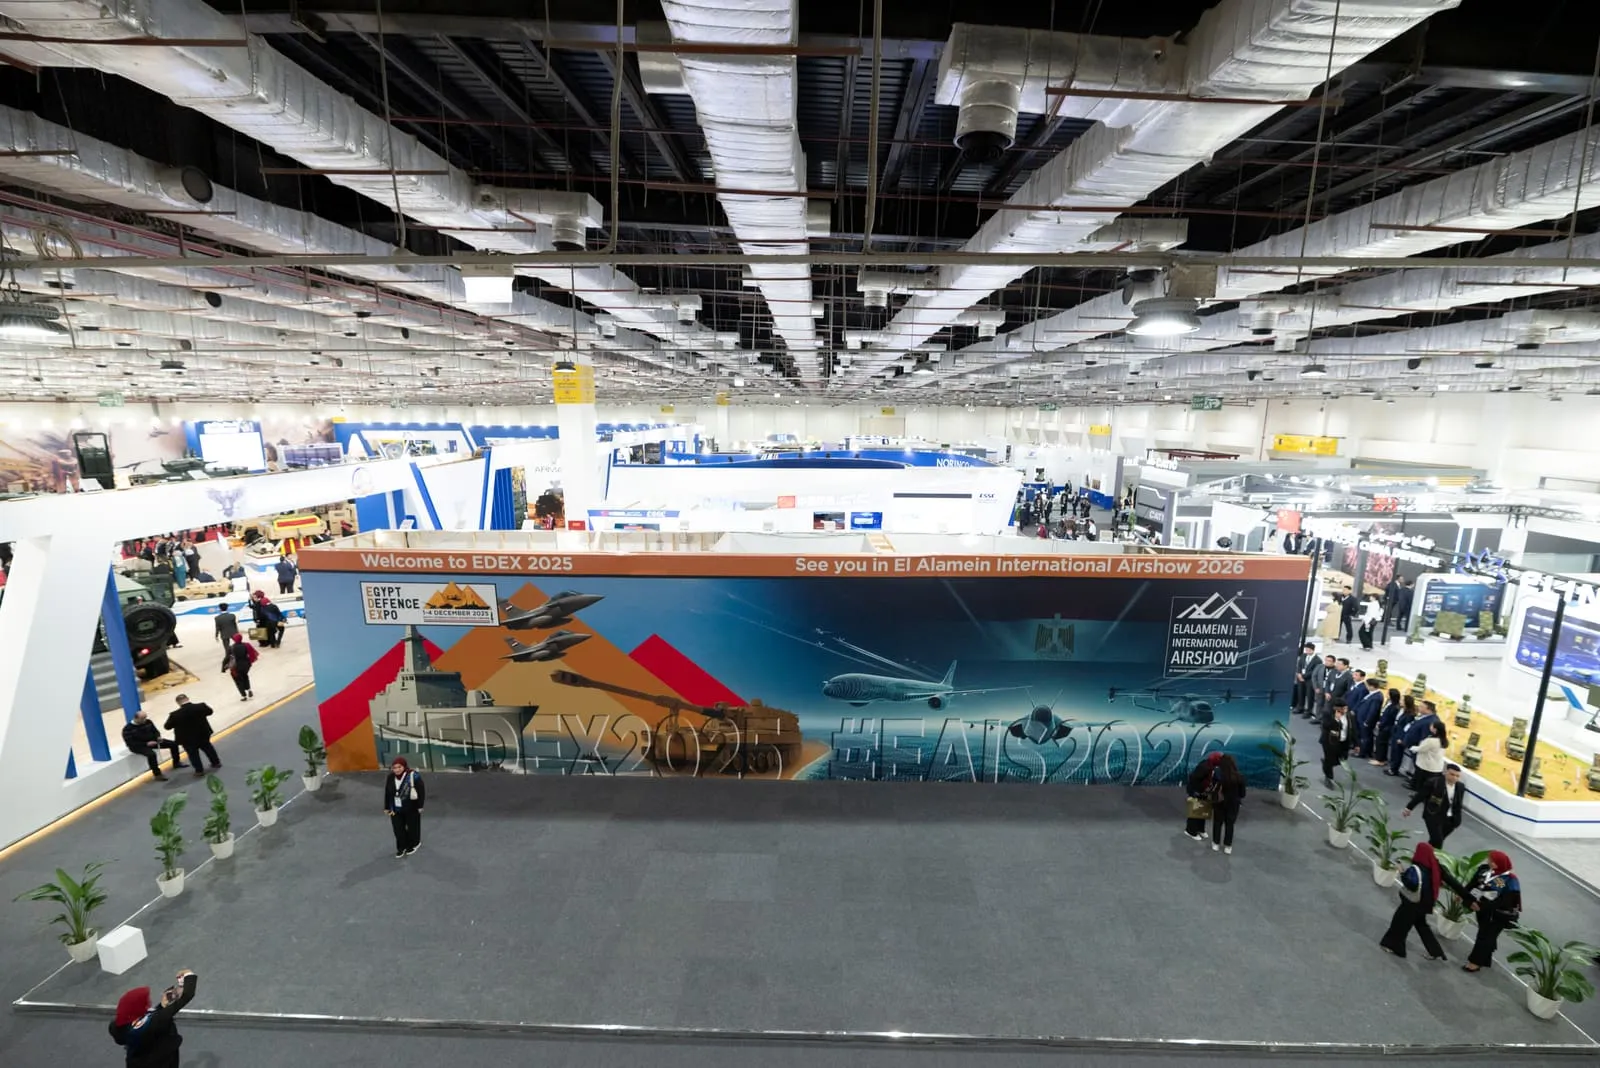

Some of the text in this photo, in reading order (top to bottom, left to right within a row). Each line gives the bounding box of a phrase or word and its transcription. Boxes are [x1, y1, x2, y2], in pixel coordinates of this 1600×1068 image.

[360, 554, 573, 571] Welcome to EDEX 2025
[795, 557, 1245, 575] See you in El Alamein International Airshow 2026
[366, 586, 401, 597] EGYPT
[368, 598, 420, 609] DEFENCE
[369, 609, 398, 620] EXPO
[1173, 623, 1228, 635] ELALAMEIN
[1172, 638, 1239, 649] INTERNATIONAL
[1170, 650, 1240, 666] AIRSHOW
[380, 711, 783, 780] #EDEX2025
